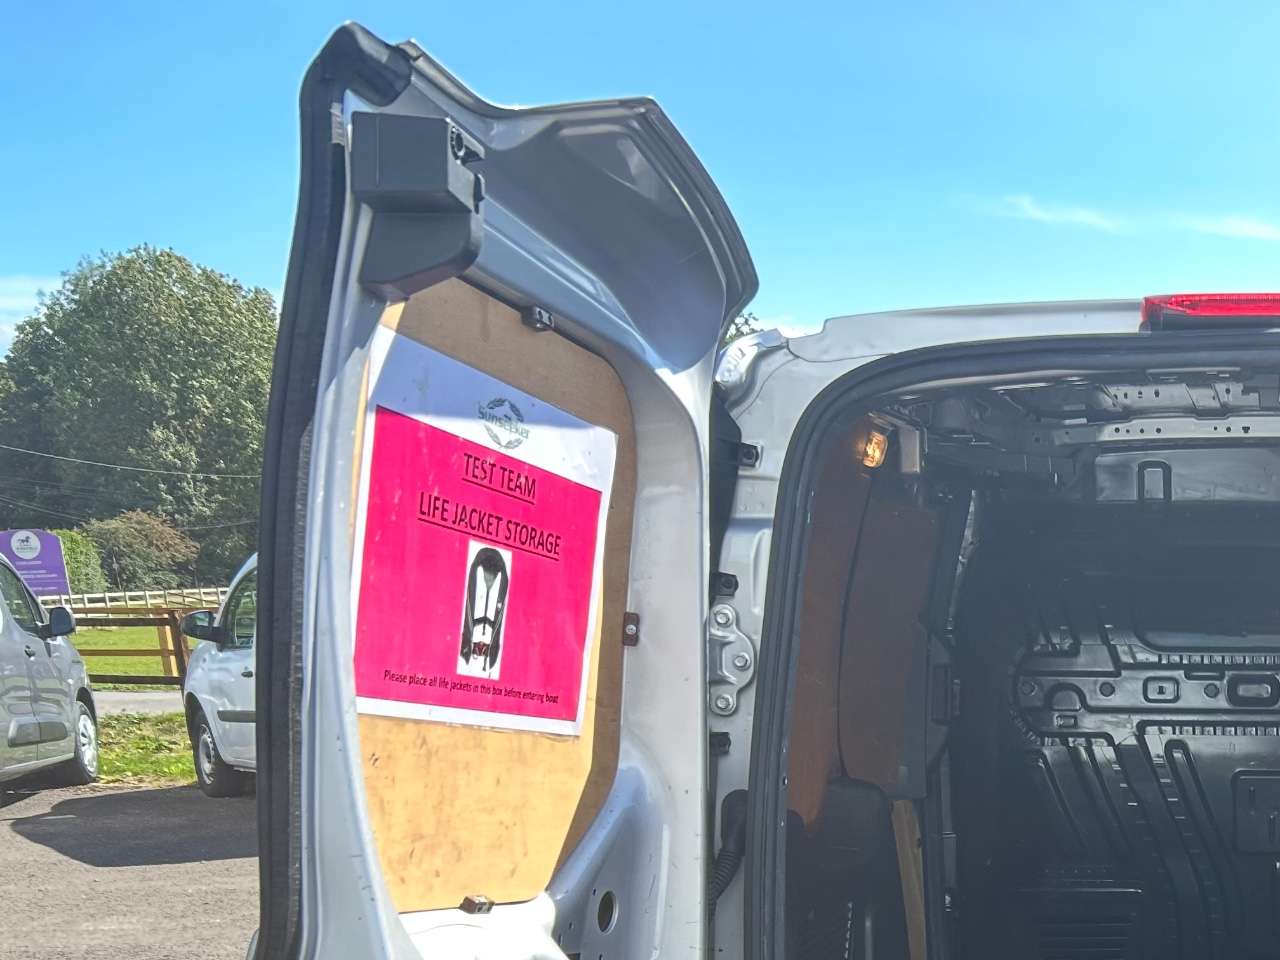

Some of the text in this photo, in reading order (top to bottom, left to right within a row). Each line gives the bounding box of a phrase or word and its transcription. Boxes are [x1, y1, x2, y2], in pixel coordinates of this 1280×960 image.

[463, 452, 537, 500] TEST TEAM
[419, 491, 562, 556] LIFE JACKET STORAGE
[384, 669, 408, 684] Please
[408, 673, 428, 687] place
[428, 676, 438, 688] all
[438, 676, 449, 689] life
[449, 679, 473, 693] jackets
[480, 684, 491, 695] this
[492, 685, 503, 697] box
[503, 687, 522, 699] before
[522, 691, 545, 704] entering
[545, 693, 559, 704] boat
